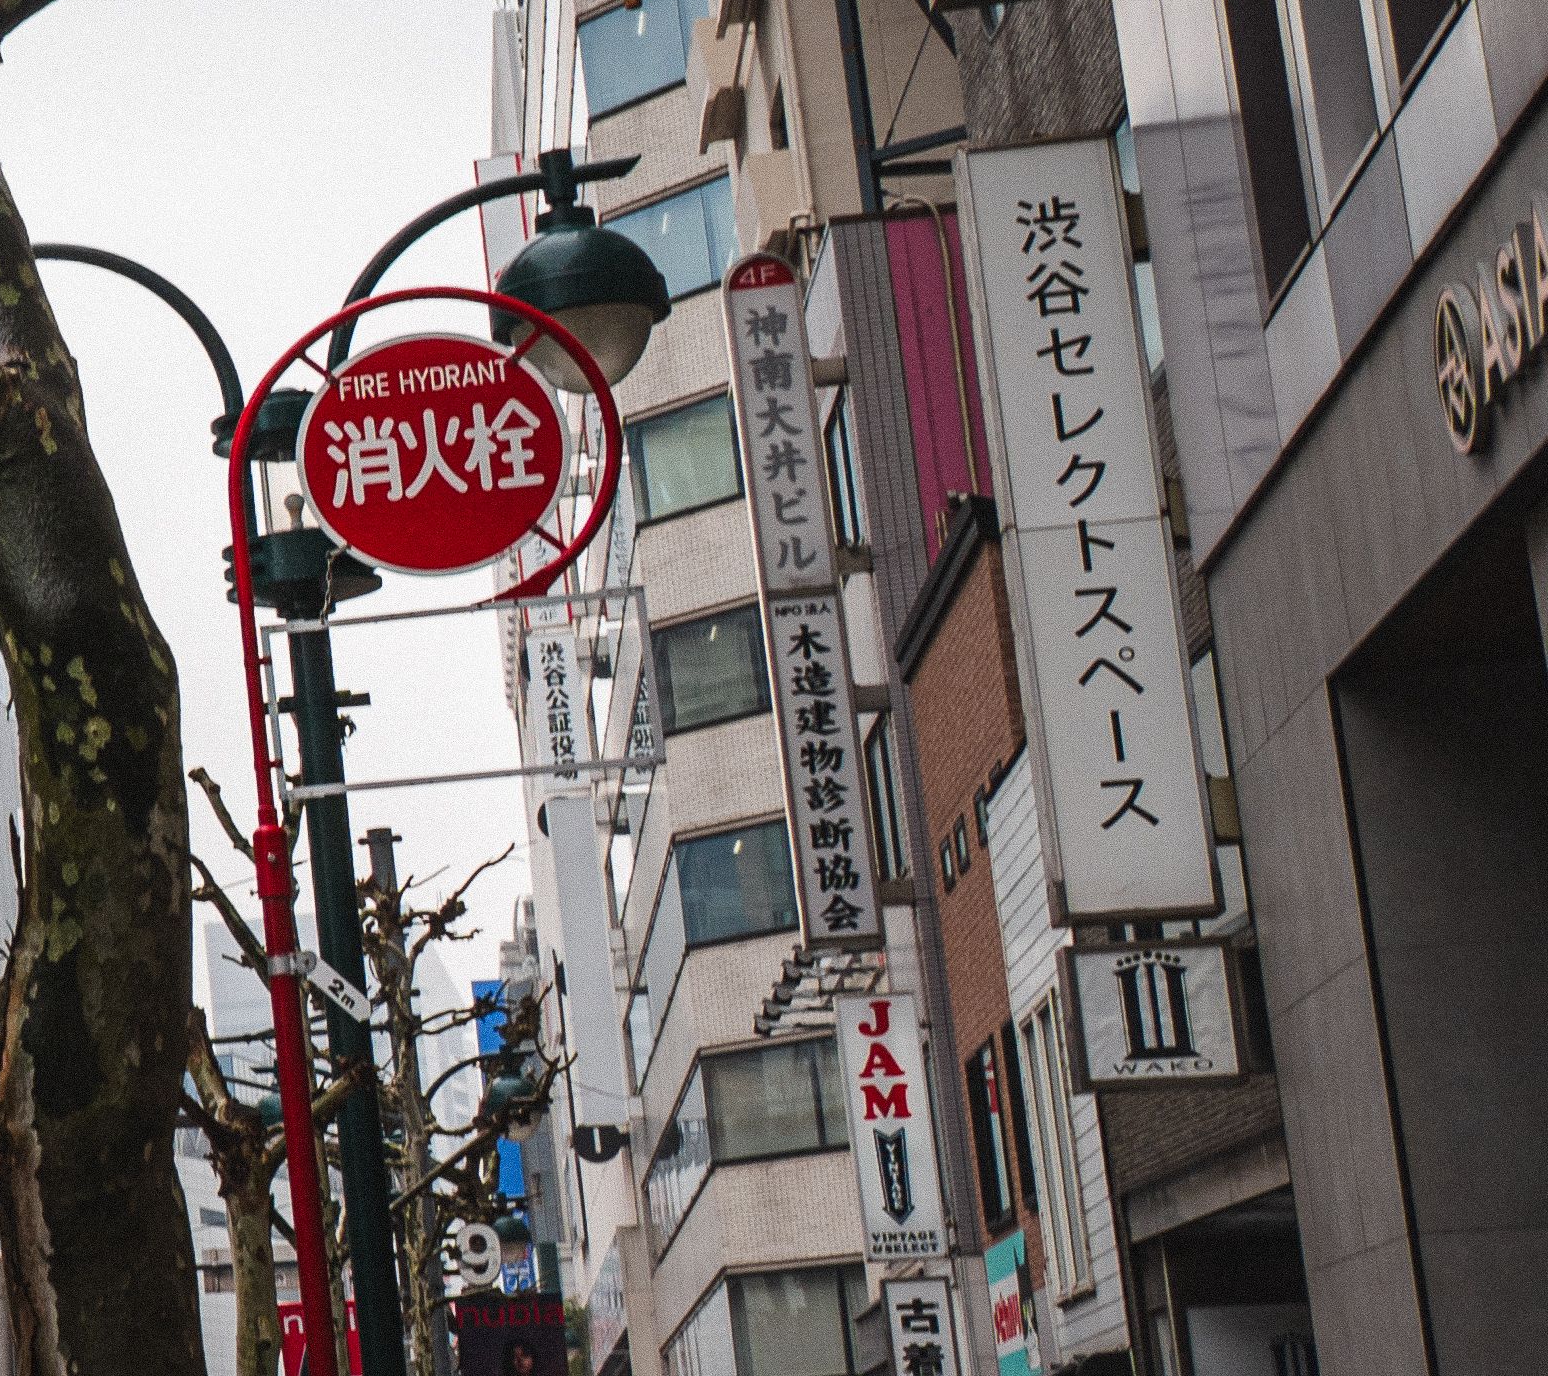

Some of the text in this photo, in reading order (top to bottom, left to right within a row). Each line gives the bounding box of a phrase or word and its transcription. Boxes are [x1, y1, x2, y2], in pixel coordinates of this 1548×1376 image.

[738, 264, 777, 287] 4F
[339, 357, 508, 403] FIRE HYDRANT
[323, 396, 546, 510] 消火栓
[745, 305, 818, 573] 神南大井ビル
[1014, 195, 1161, 832] 渋谷セレクトスペース
[786, 623, 865, 932] 木造建物診断協会
[857, 999, 912, 1122] JAM
[1114, 1058, 1216, 1076] WAKO
[871, 1230, 937, 1243] VINTAGE
[456, 1301, 565, 1327] nubia
